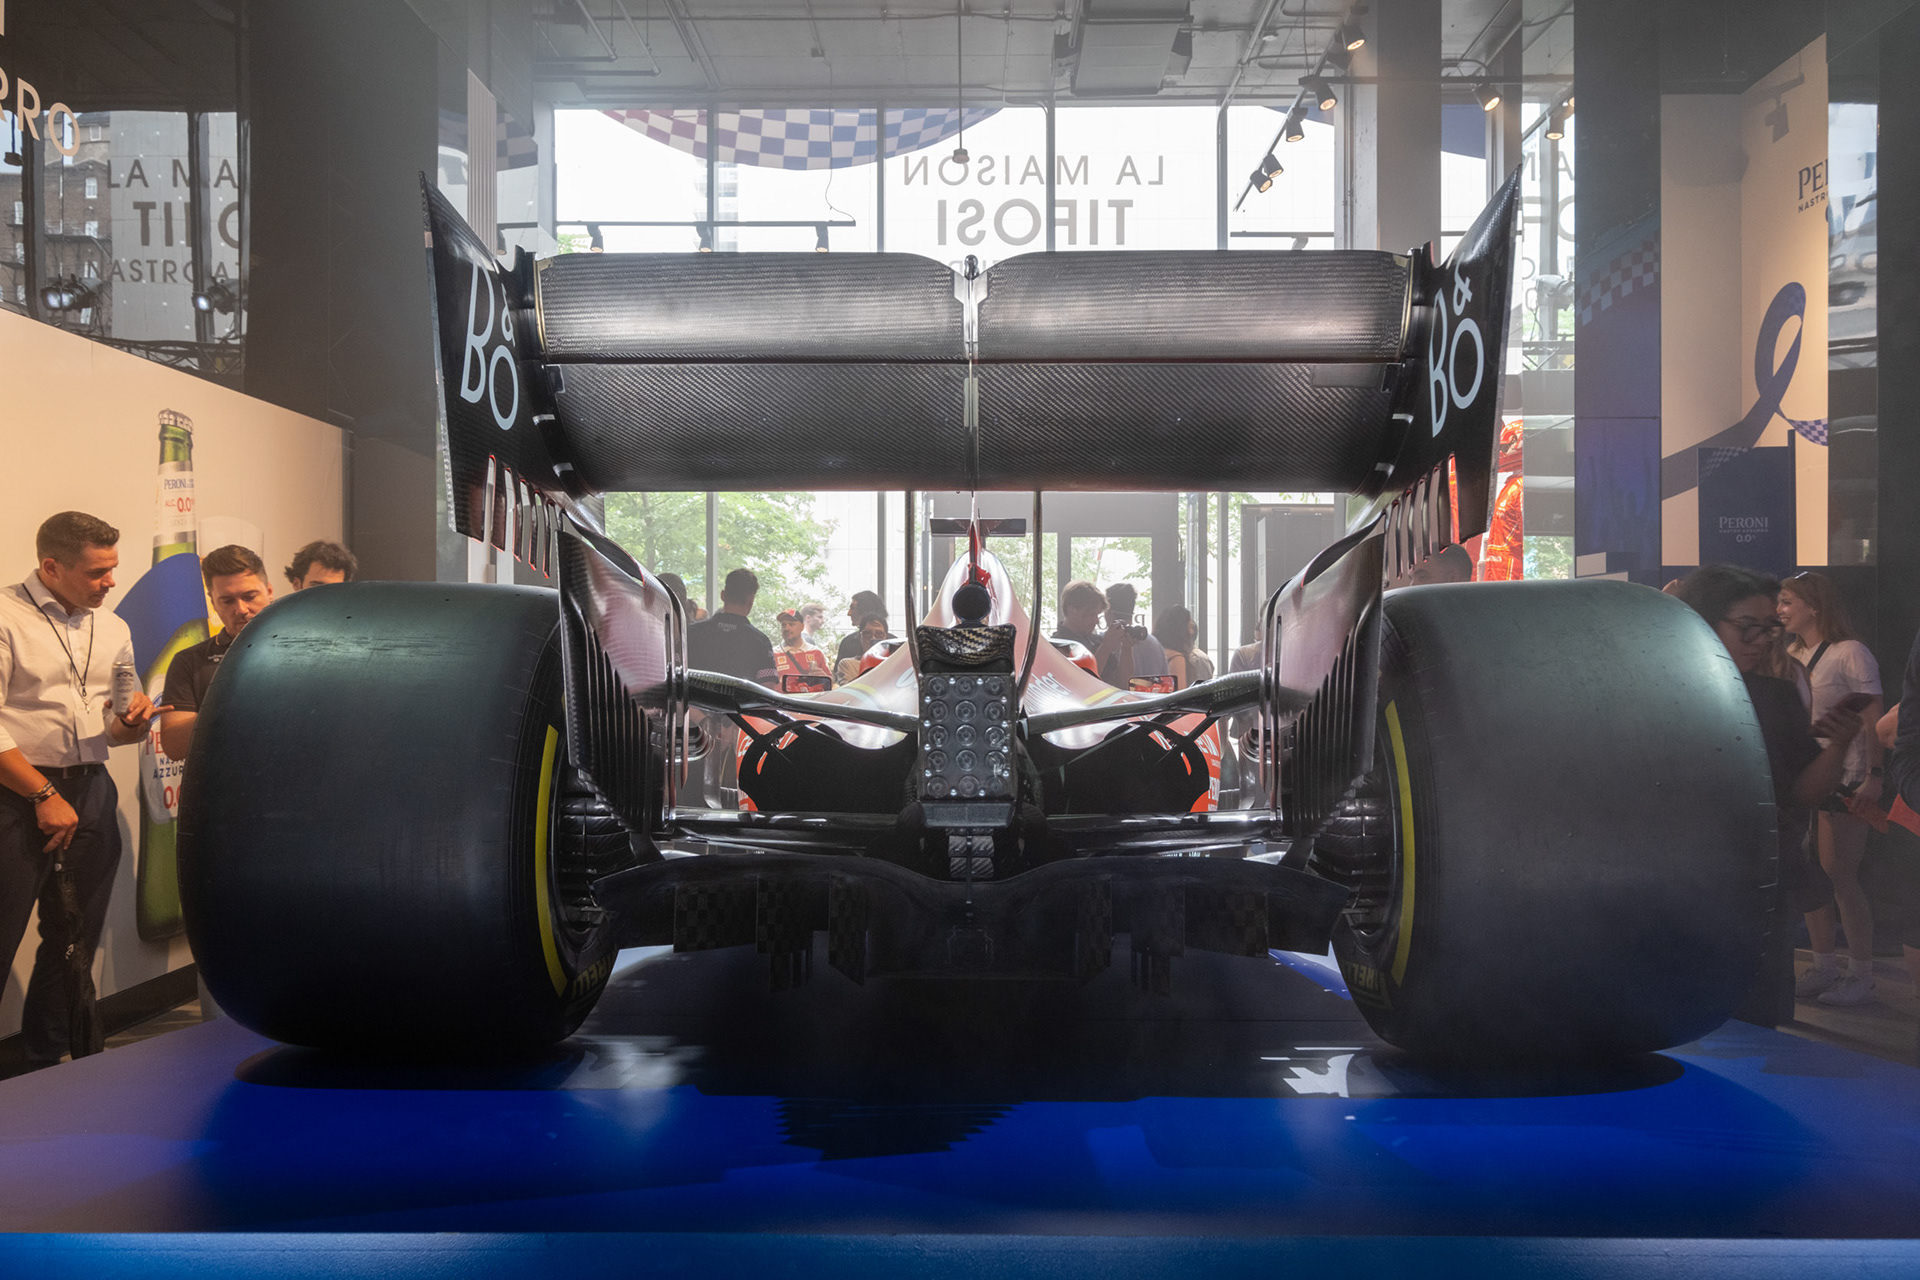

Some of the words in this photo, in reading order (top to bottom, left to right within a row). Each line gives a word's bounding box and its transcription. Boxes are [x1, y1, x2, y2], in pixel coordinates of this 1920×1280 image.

[107, 159, 148, 188] LA
[1798, 158, 1828, 200] PE
[1798, 192, 1828, 213] NASTR
[1719, 516, 1769, 529] PERONI
